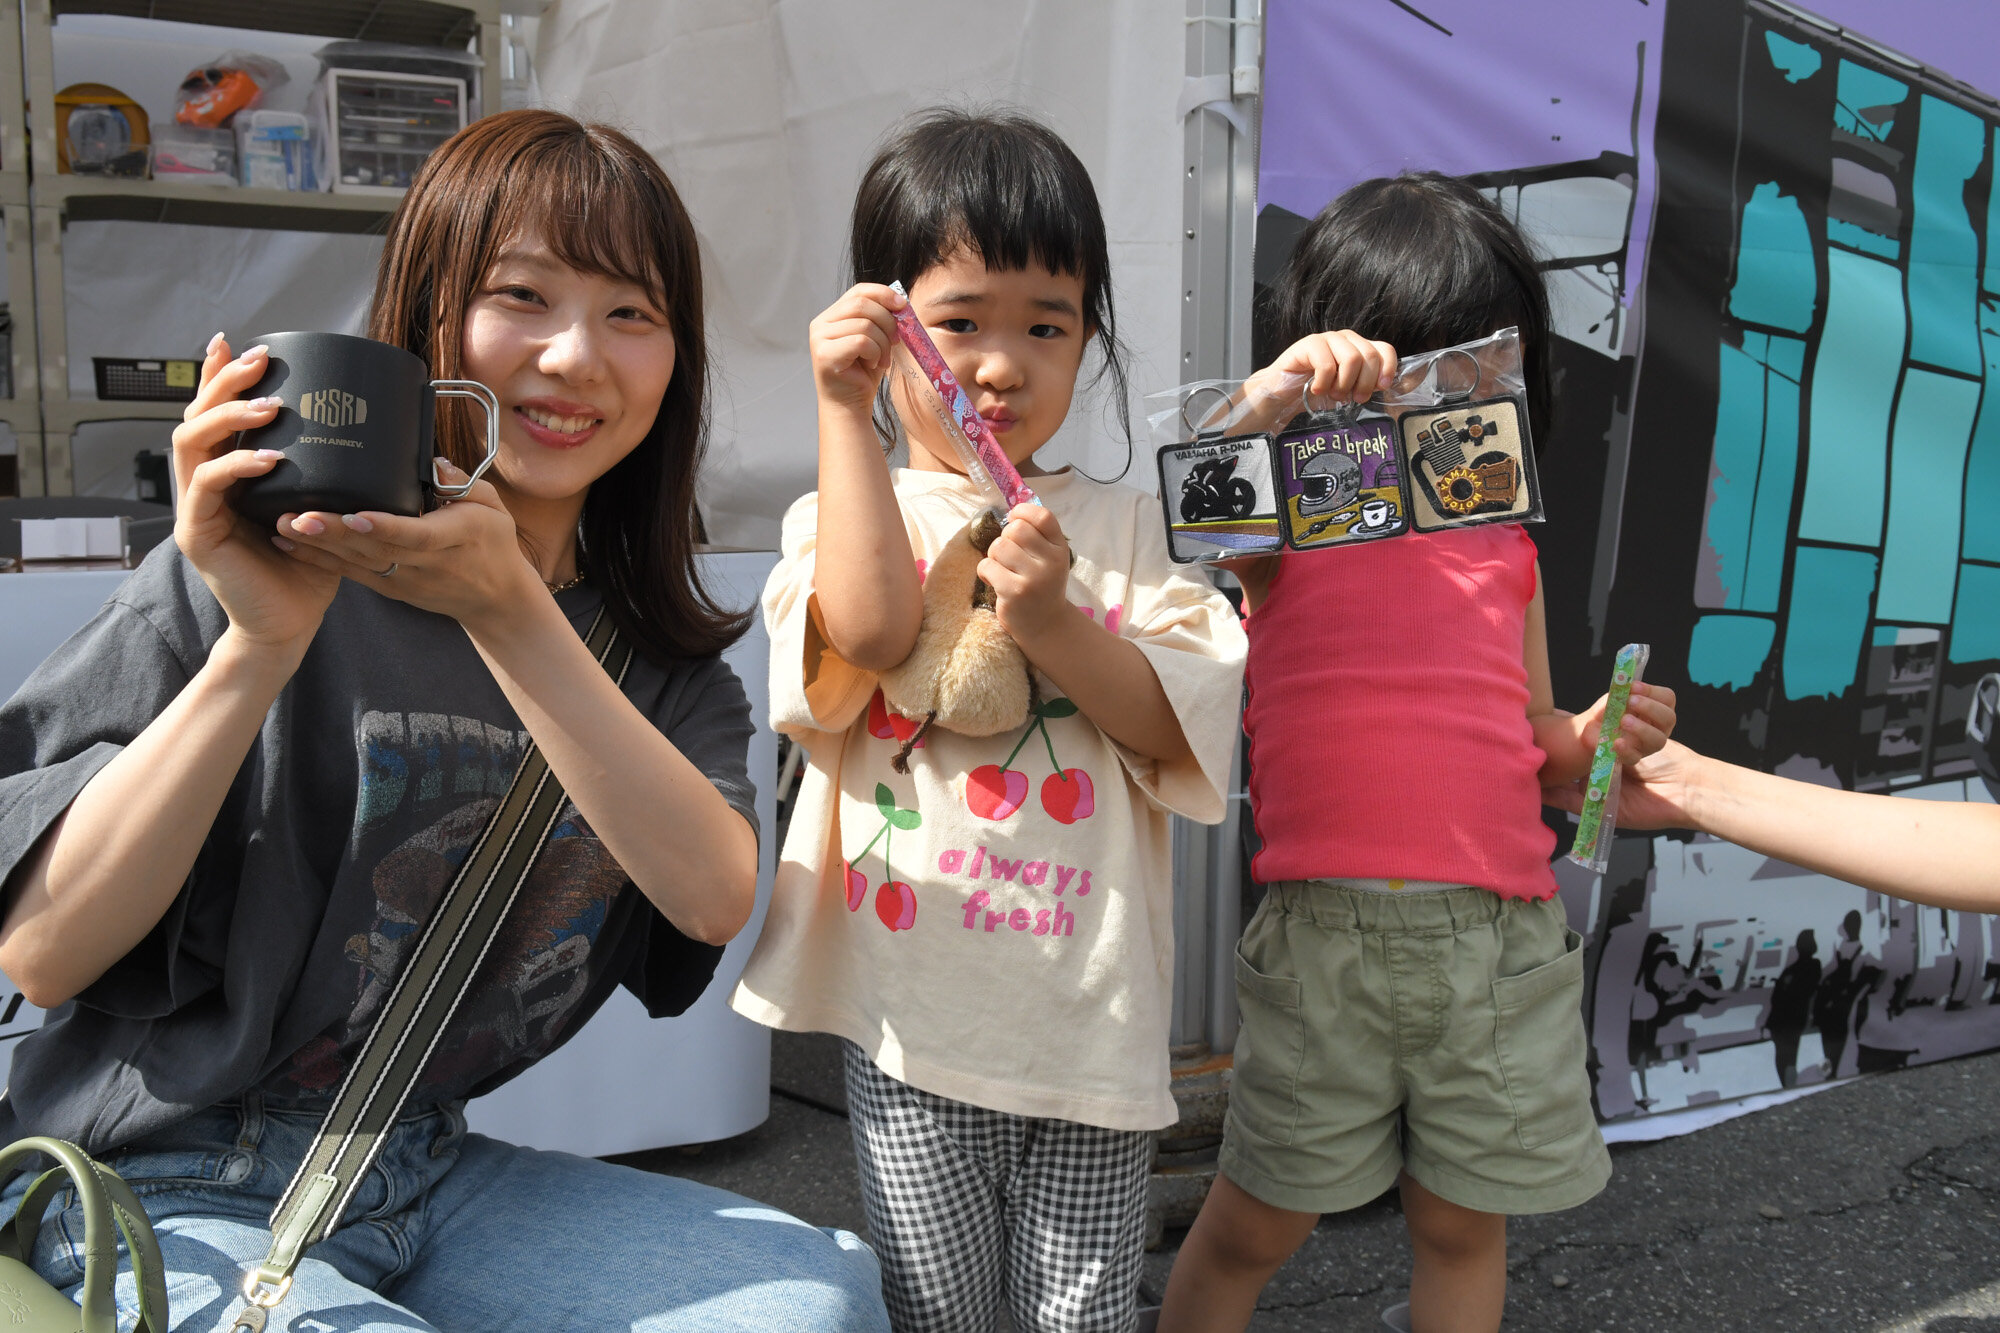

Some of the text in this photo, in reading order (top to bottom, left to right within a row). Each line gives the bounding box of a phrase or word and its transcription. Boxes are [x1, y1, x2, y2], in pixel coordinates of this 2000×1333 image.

[313, 388, 354, 428] XSR
[299, 436, 364, 449] 10TH ANNIV.
[1174, 441, 1254, 460] YAMAHA R-DNA
[1284, 437, 1326, 480] Take
[1332, 434, 1341, 450] a
[1344, 427, 1388, 464] break
[1441, 469, 1482, 490] YAMAHA
[1443, 492, 1482, 510] MOTOR
[938, 846, 1093, 897] always
[961, 889, 1075, 937] fresh
